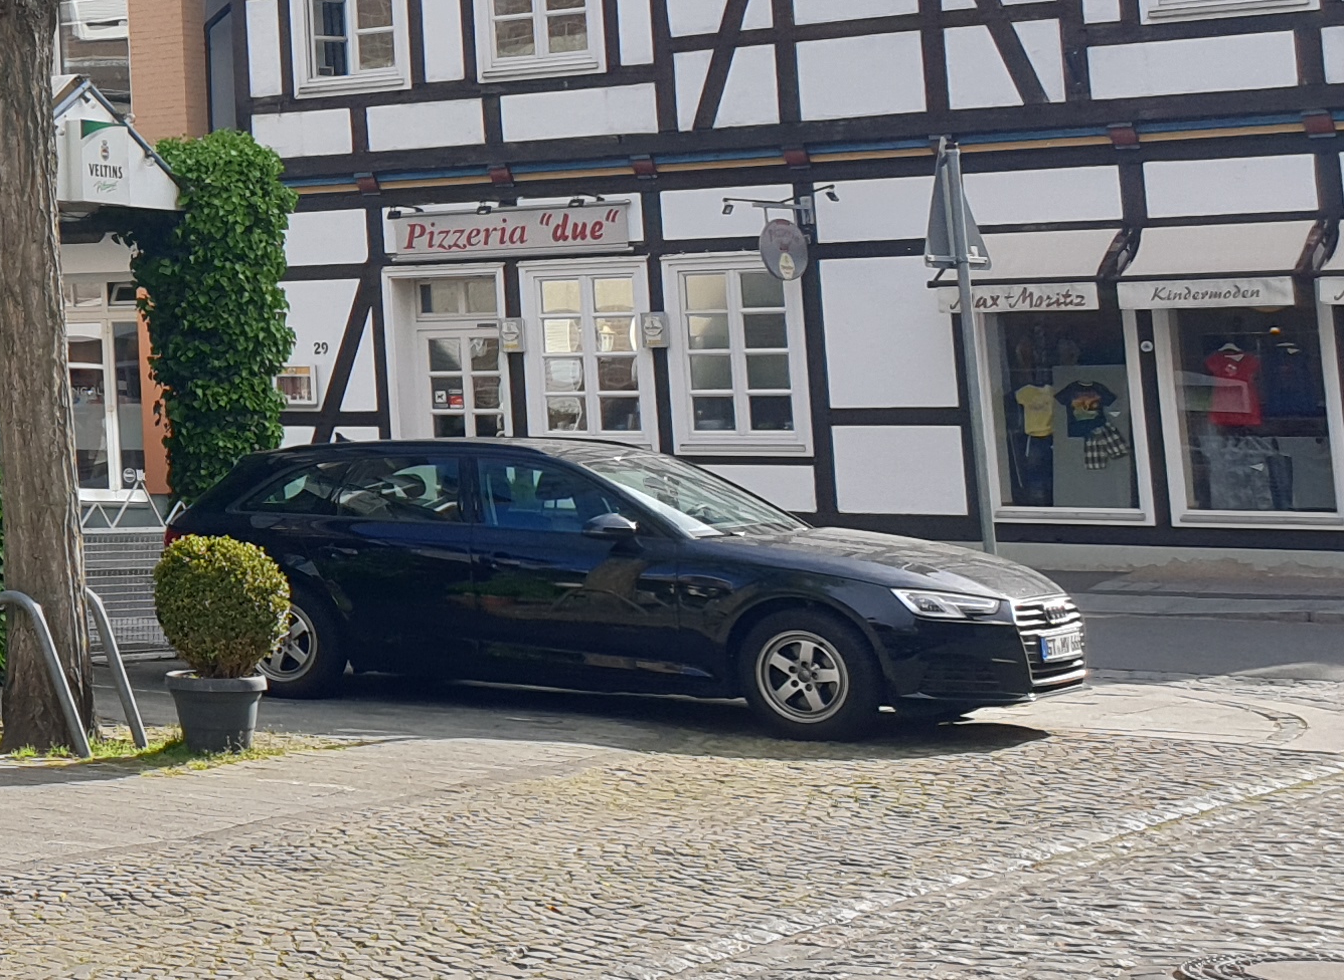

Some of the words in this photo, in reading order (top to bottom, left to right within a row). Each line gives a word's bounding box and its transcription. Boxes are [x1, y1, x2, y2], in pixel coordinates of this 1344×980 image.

[88, 163, 123, 179] VELTINS
[403, 218, 528, 251] Pizzeria
[950, 292, 1001, 309] ax
[1151, 284, 1260, 301] Kindermoden
[313, 341, 329, 355] 29
